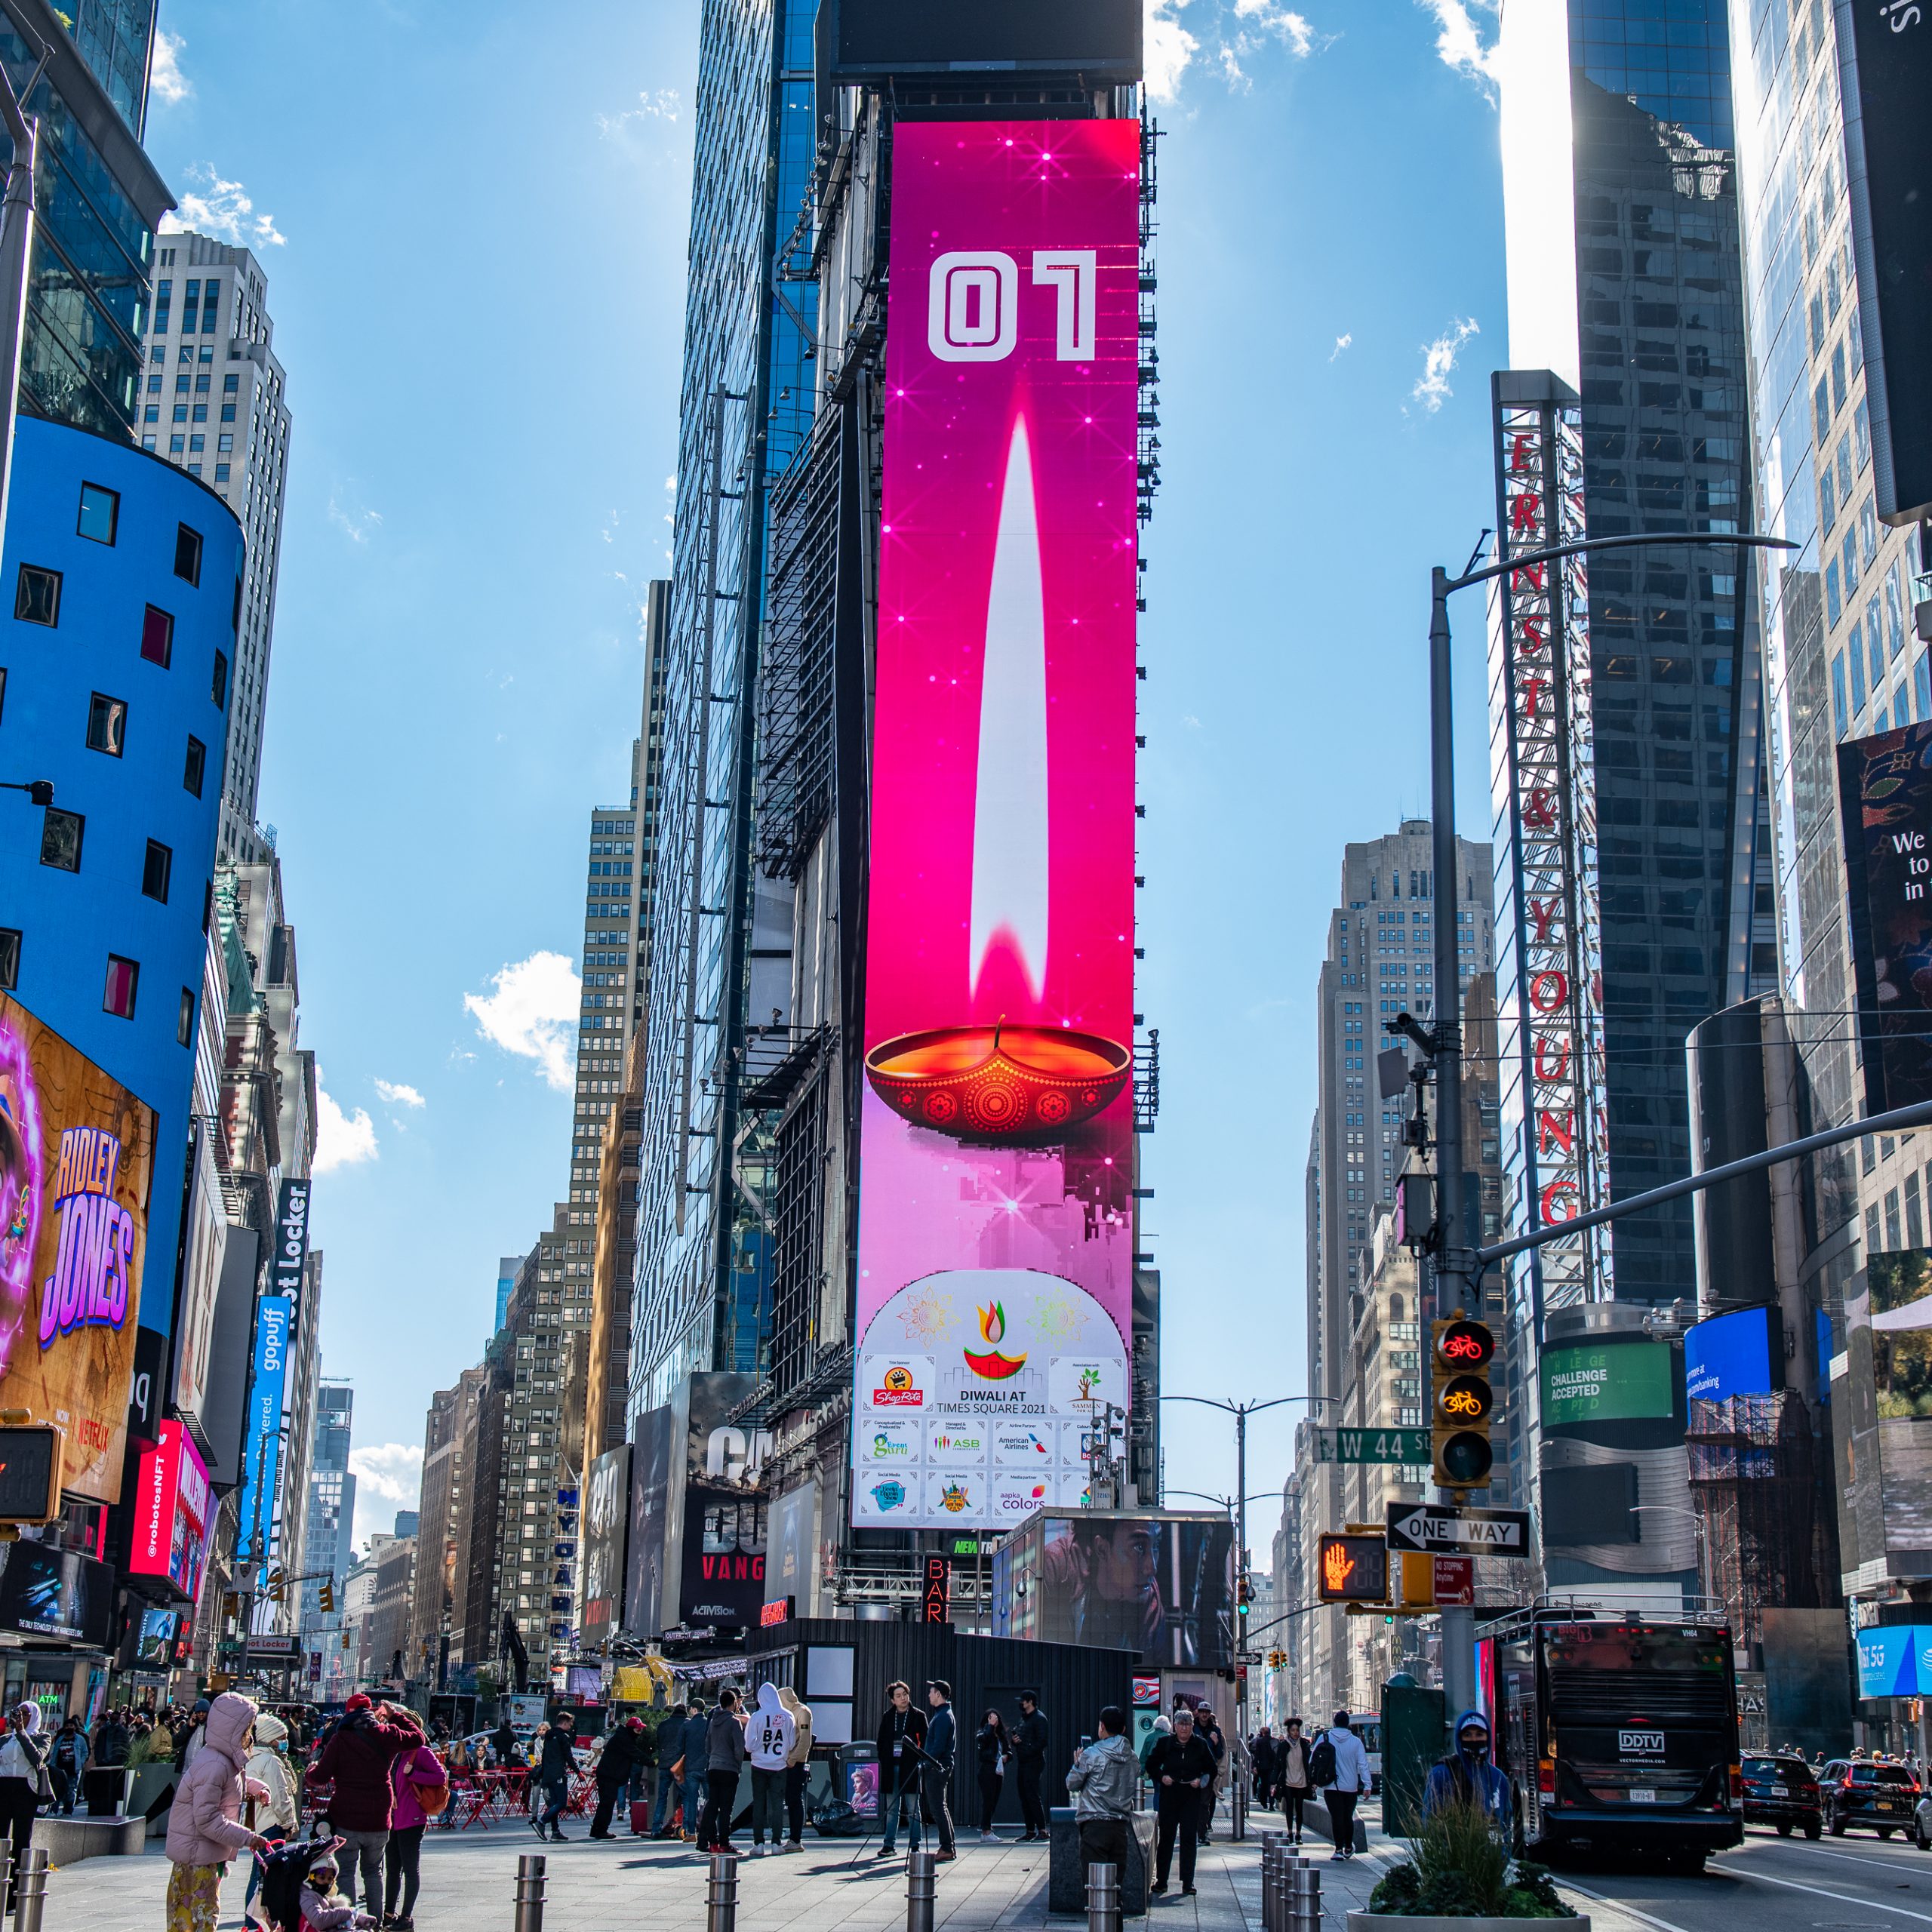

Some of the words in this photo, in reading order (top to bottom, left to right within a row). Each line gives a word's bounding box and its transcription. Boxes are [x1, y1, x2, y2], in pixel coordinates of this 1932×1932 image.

[928, 250, 1097, 362] 01
[1512, 434, 1547, 716] ERNST
[1524, 787, 1558, 828] &
[1891, 830, 1925, 854] We
[1909, 856, 1930, 875] to
[1904, 881, 1924, 901] in
[1530, 900, 1578, 1225] YOUNG
[54, 1127, 119, 1203] RIDLEY
[278, 1186, 307, 1269] Locker
[39, 1194, 134, 1346] JONES
[263, 1306, 285, 1371] gopuff
[1551, 1368, 1607, 1387] CHALLENGE
[1700, 1364, 1706, 1374] at
[875, 1392, 921, 1404] ShopRite
[960, 1390, 1006, 1401] DIWALI
[1009, 1391, 1026, 1401] AT
[1551, 1383, 1601, 1401] ACCEPTED
[56, 1407, 69, 1424] NOW
[937, 1403, 971, 1414] TIMES
[973, 1404, 1019, 1415] SQUARE
[1021, 1404, 1046, 1414] 2021
[78, 1417, 109, 1454] NETFLIX
[953, 1439, 980, 1447] ASB
[1342, 1432, 1362, 1459] W
[1374, 1432, 1404, 1460] 44
[1414, 1434, 1430, 1450] St
[1000, 1491, 1020, 1500] aapka
[1002, 1498, 1045, 1509] colors
[148, 1454, 165, 1558] @robotosNFT
[705, 1518, 718, 1532] OF
[1409, 1518, 1448, 1539] ONE
[1468, 1522, 1512, 1543] WAY
[954, 1541, 978, 1554] NEW
[702, 1556, 764, 1580] VANG
[1435, 1561, 1442, 1571] NO
[1443, 1561, 1464, 1572] STOPPING
[1435, 1573, 1454, 1583] Anytime
[927, 1559, 944, 1623] BAR
[137, 1613, 149, 1657] GARMIN
[1558, 1625, 1577, 1634] BIG
[1682, 1629, 1698, 1638] VH64
[262, 1640, 290, 1648] Locker
[1870, 1644, 1885, 1668] 5G
[38, 1695, 58, 1704] ATM
[766, 1715, 770, 1727] I
[1623, 1734, 1660, 1748] DDTV
